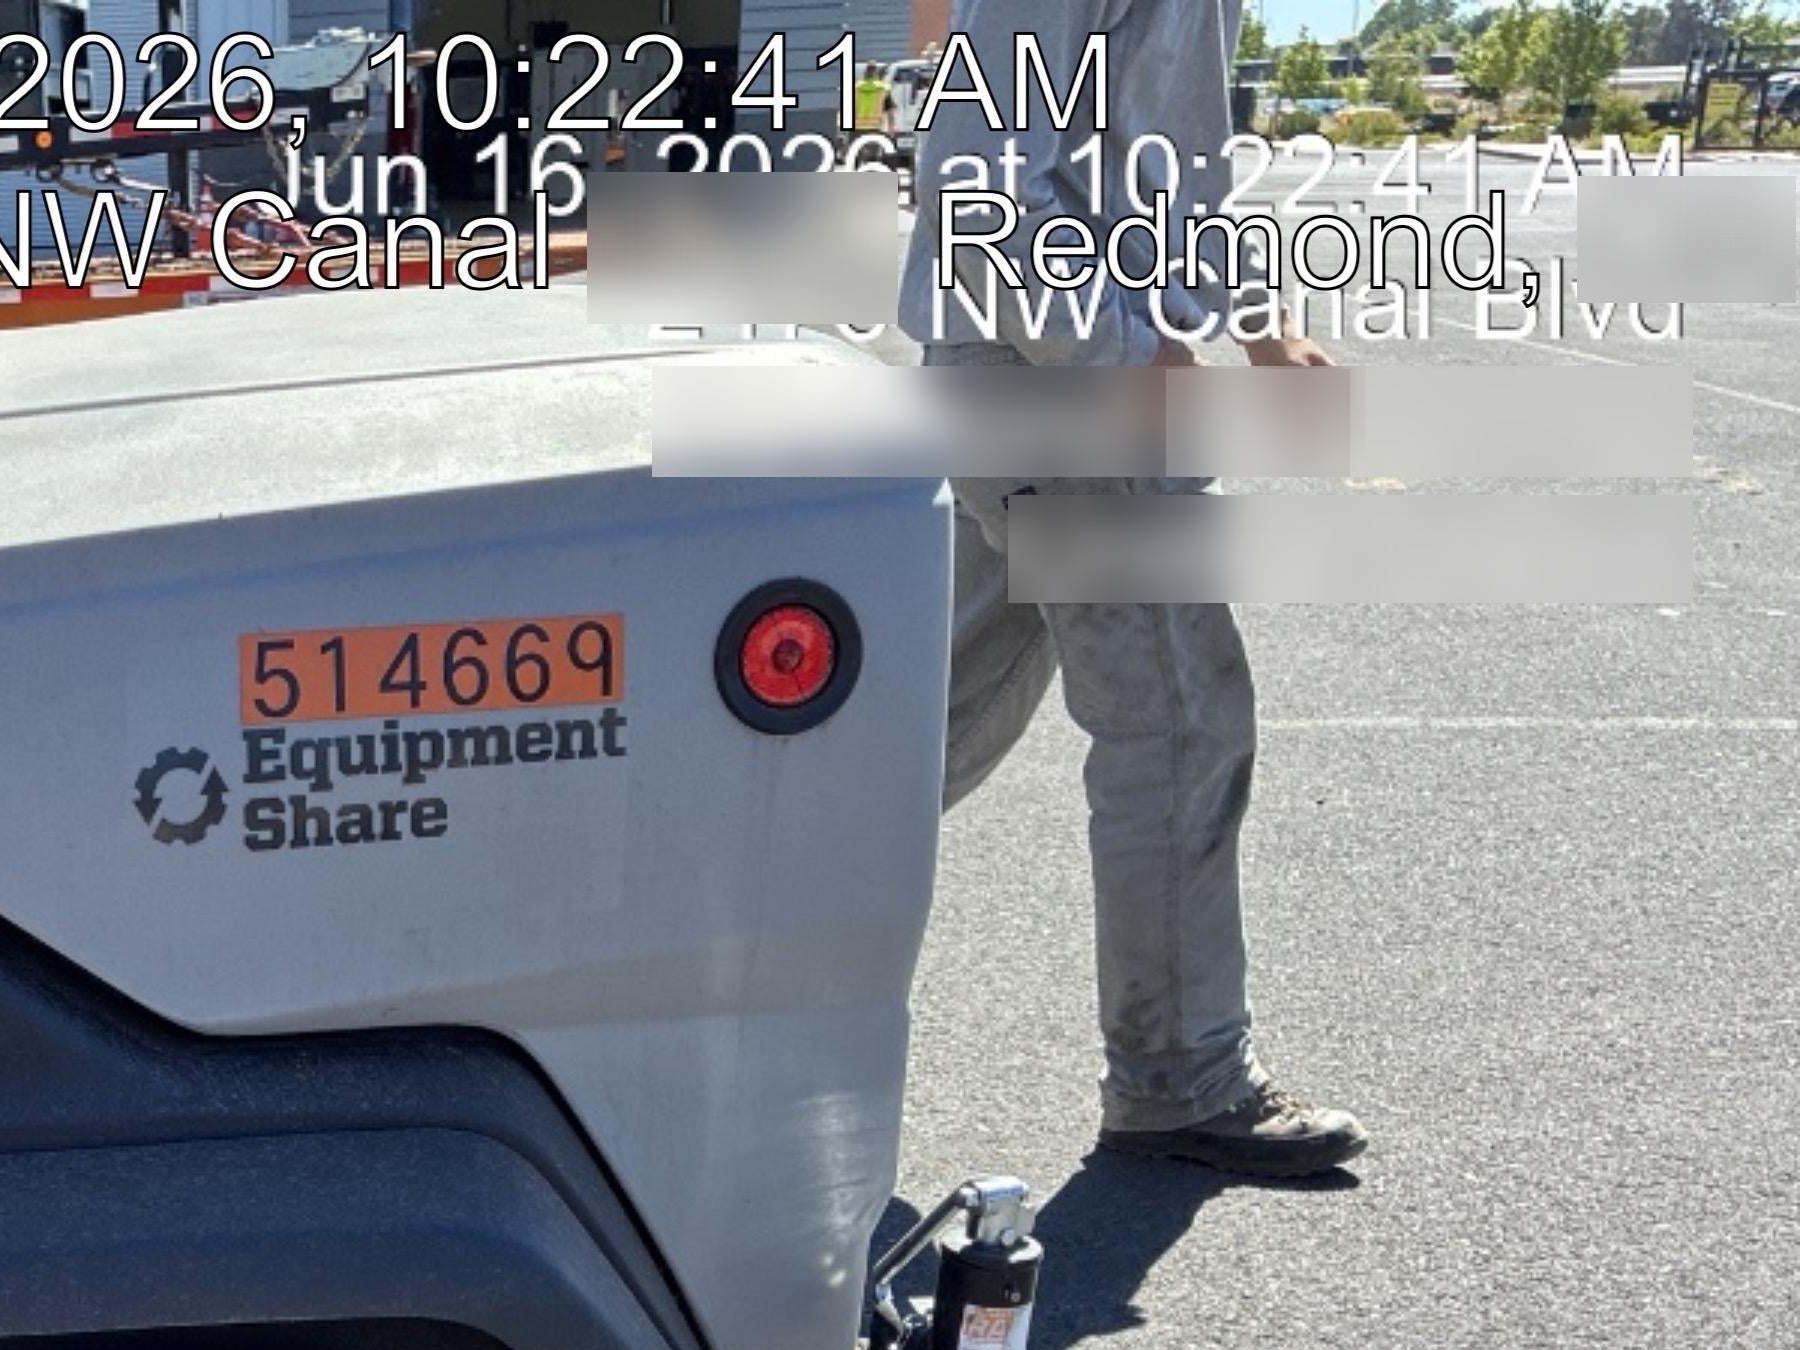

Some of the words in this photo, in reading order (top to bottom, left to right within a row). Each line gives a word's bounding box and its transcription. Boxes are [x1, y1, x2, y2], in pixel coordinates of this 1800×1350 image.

[252, 620, 613, 718] 514669
[242, 707, 628, 792] Equipment
[243, 794, 449, 852] Share
